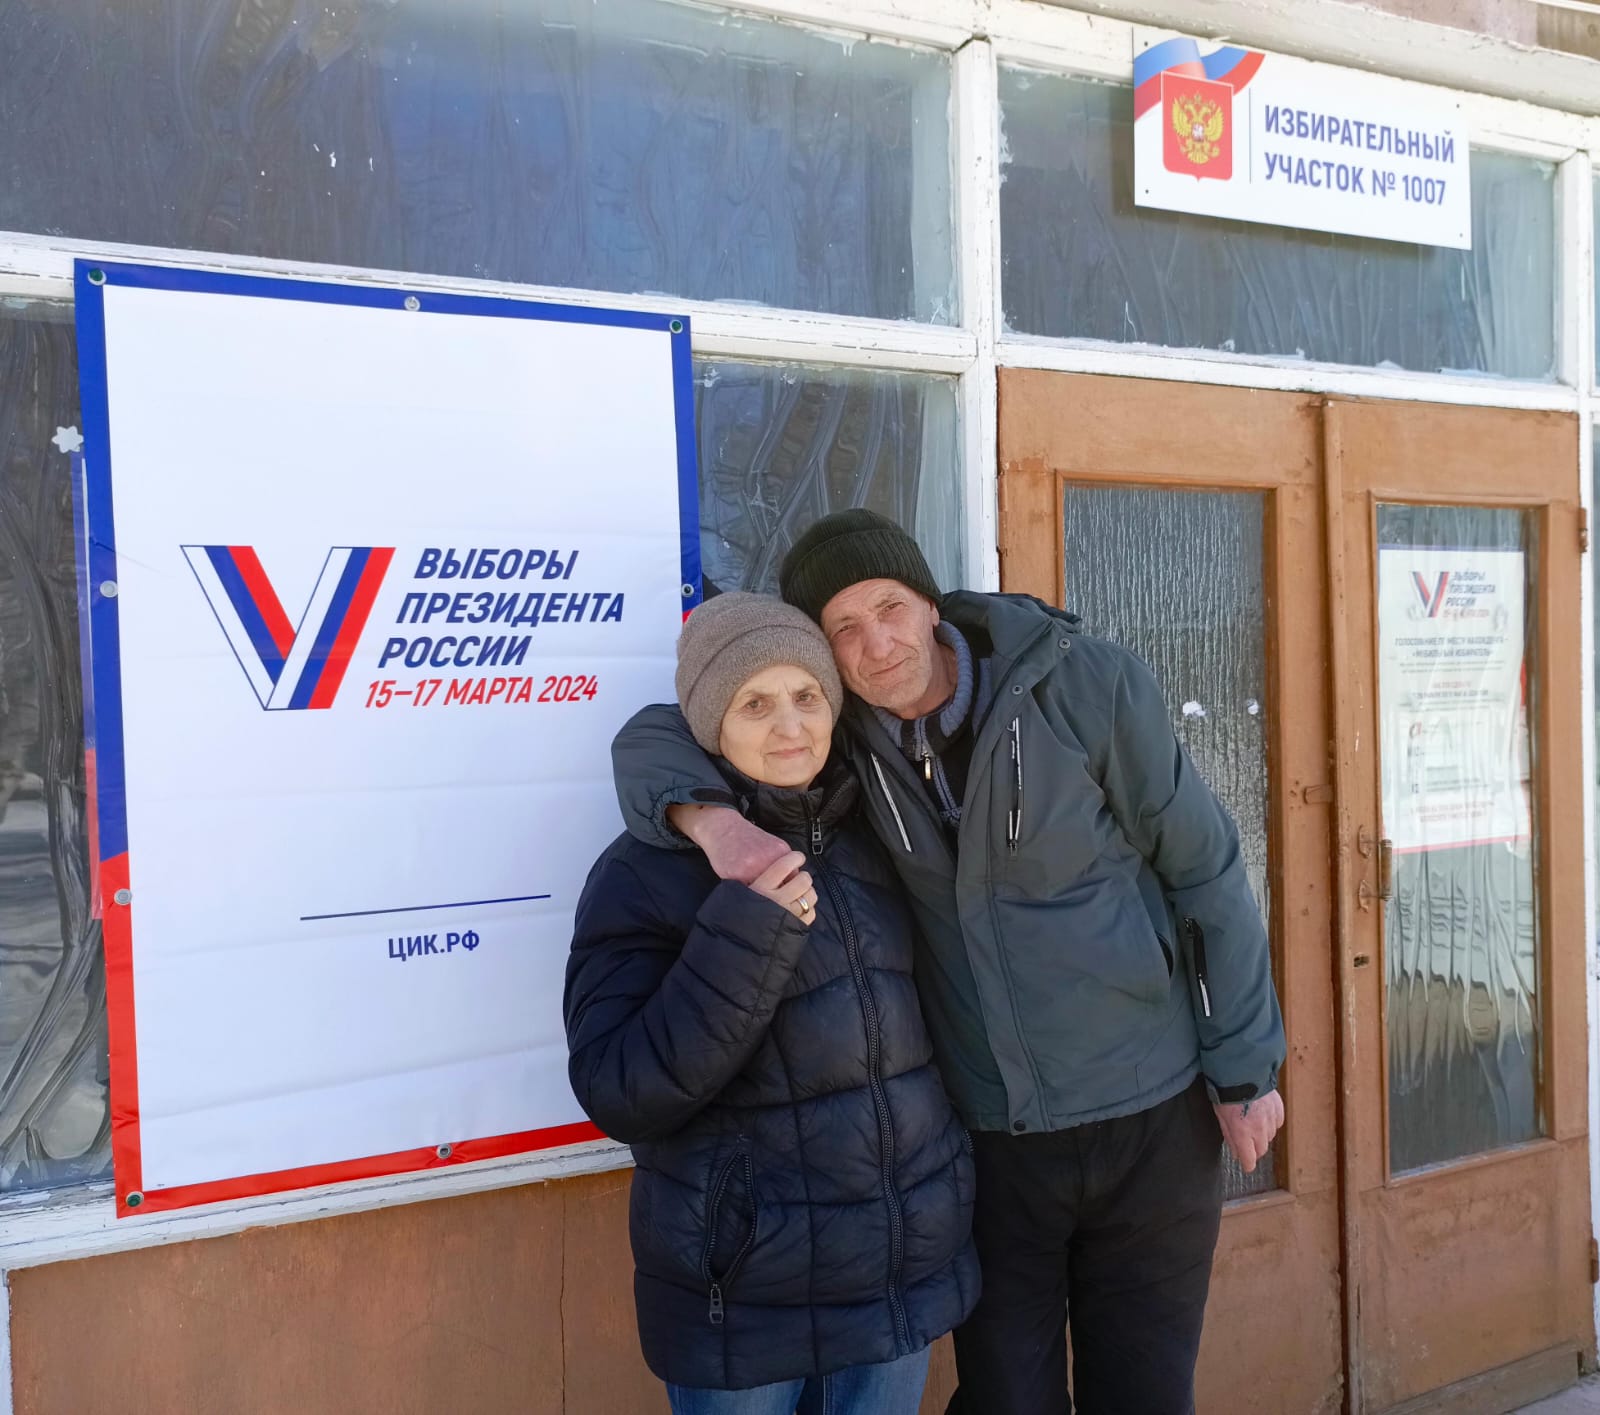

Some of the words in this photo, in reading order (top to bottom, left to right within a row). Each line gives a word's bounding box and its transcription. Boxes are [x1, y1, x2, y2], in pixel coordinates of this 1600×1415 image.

[1264, 104, 1455, 164] ИЗБИРАТЕЛЬНЫЙ
[1264, 152, 1364, 194] УЧАСТОК
[1372, 169, 1395, 197] №
[1402, 174, 1446, 206] 1007
[414, 548, 579, 580] ВЫБОРЫ
[396, 592, 625, 628] ПРЕЗИДЕНТА
[378, 635, 532, 668] РОССИИ
[365, 678, 442, 709] 15–17
[443, 677, 533, 706] МАРТА
[537, 675, 598, 703] 2024
[388, 930, 480, 962] ЦИК.РФ
